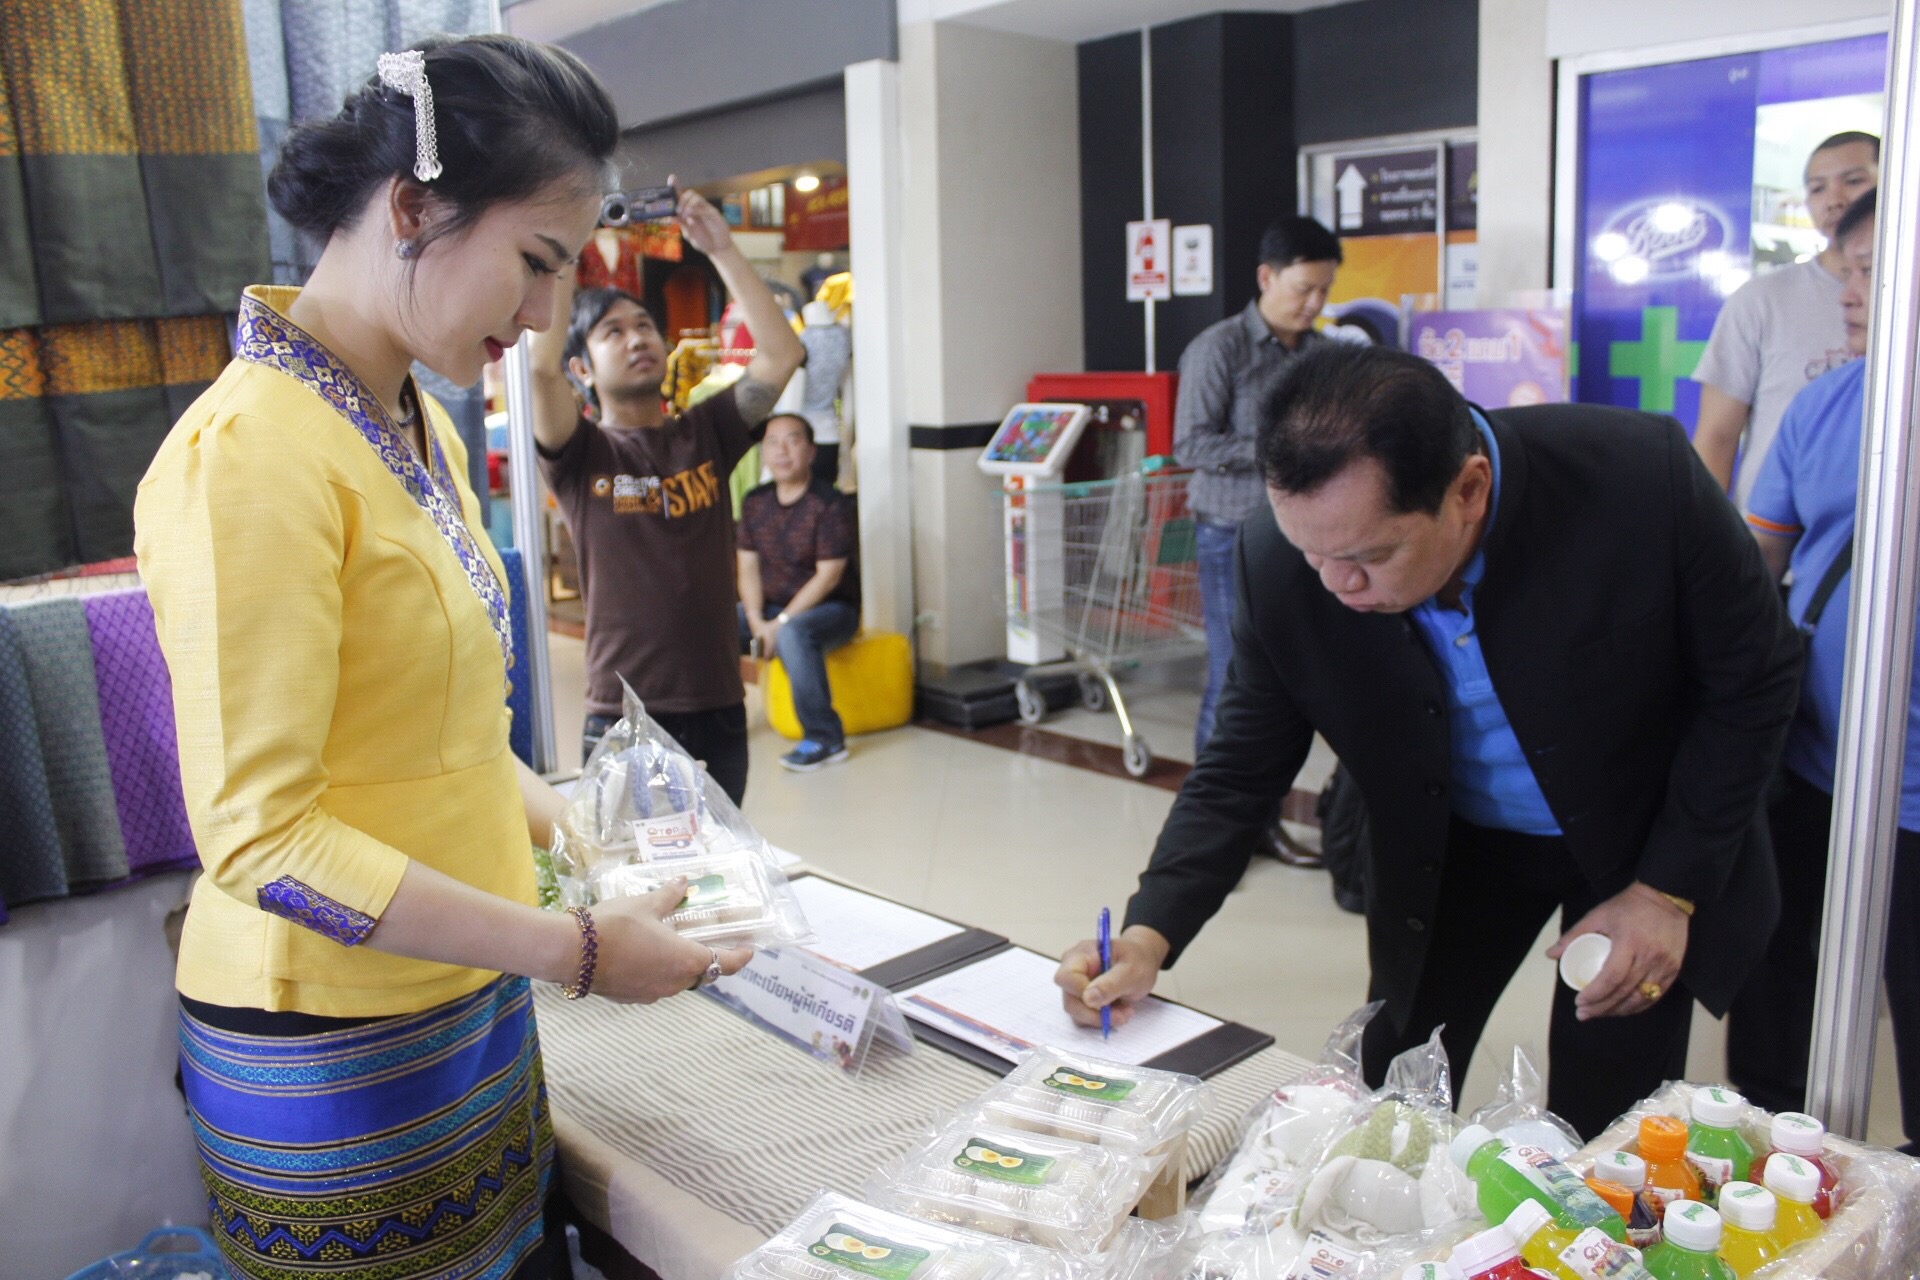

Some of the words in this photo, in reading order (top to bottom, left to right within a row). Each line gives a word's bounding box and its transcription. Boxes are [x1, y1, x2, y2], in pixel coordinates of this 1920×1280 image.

[1445, 328, 1465, 361] 2
[737, 967, 857, 1034] งทะเบียนผู้มีเกียรติ
